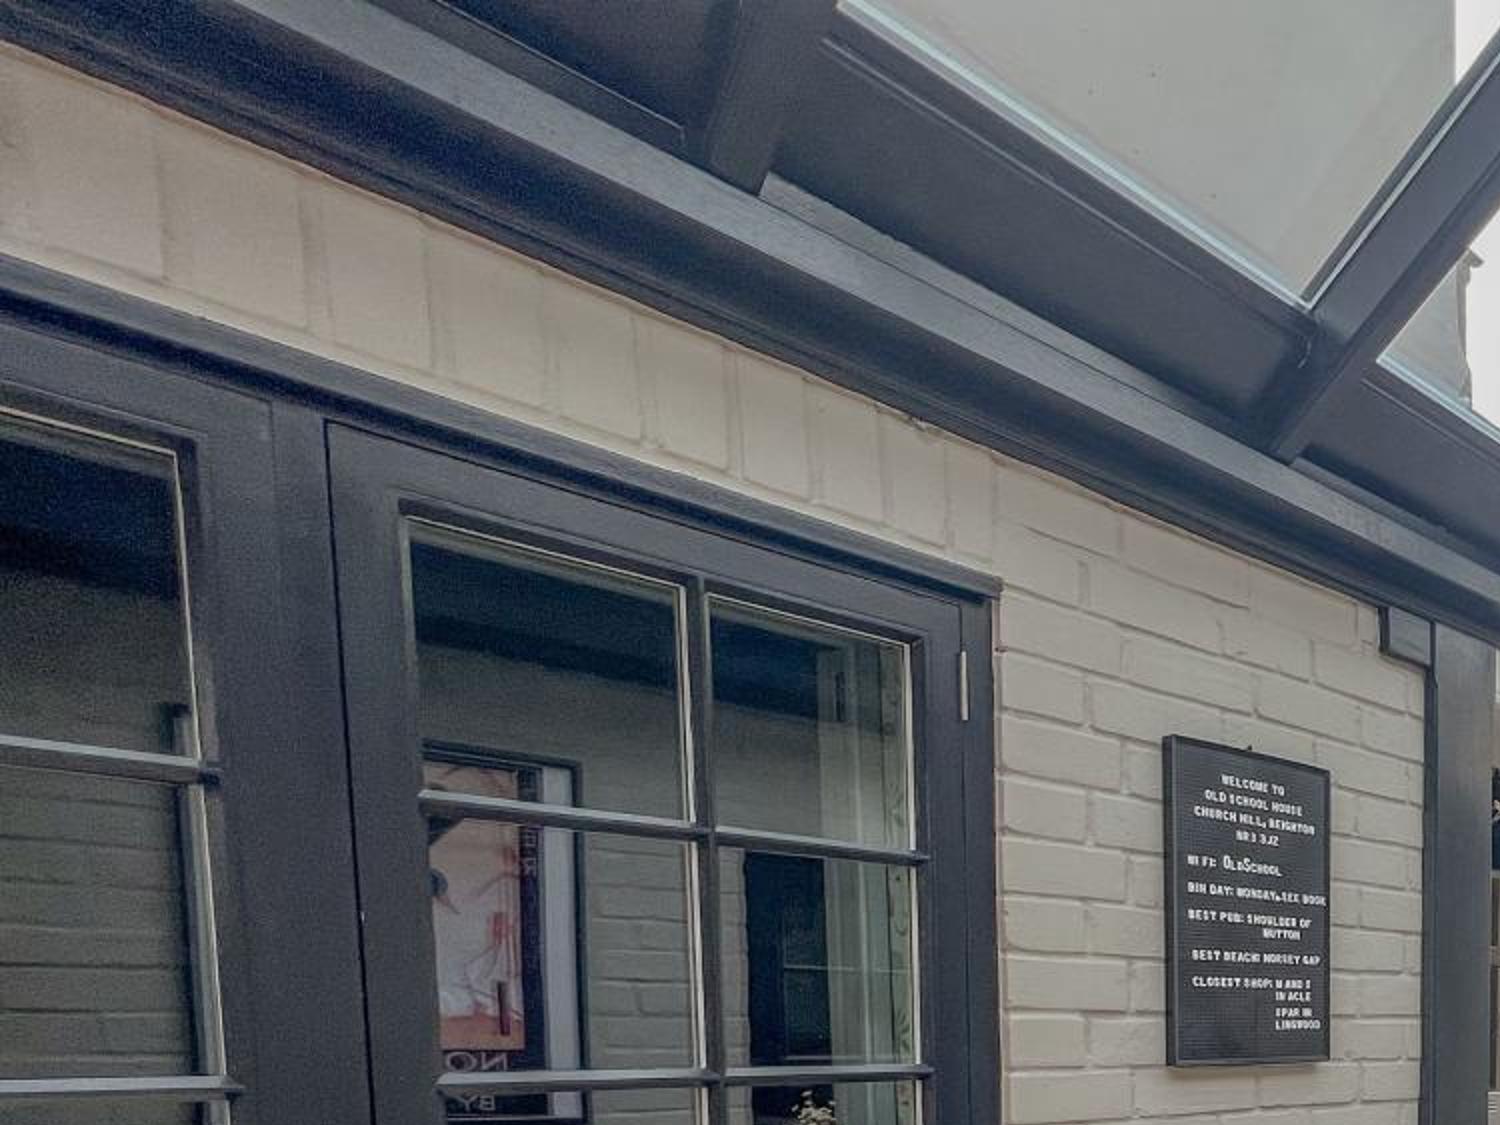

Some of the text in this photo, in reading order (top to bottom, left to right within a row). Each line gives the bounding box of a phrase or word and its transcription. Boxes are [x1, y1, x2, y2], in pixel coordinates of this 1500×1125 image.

[1221, 774, 1285, 797] WELCOME TO
[1204, 789, 1302, 817] OLD SCHOOL HOUSE
[1194, 805, 1237, 822] CHURCH
[1187, 881, 1207, 895] BIN
[1187, 909, 1217, 921] BEST
[1191, 950, 1221, 961] BEST
[1192, 976, 1241, 988] CLOSEST
